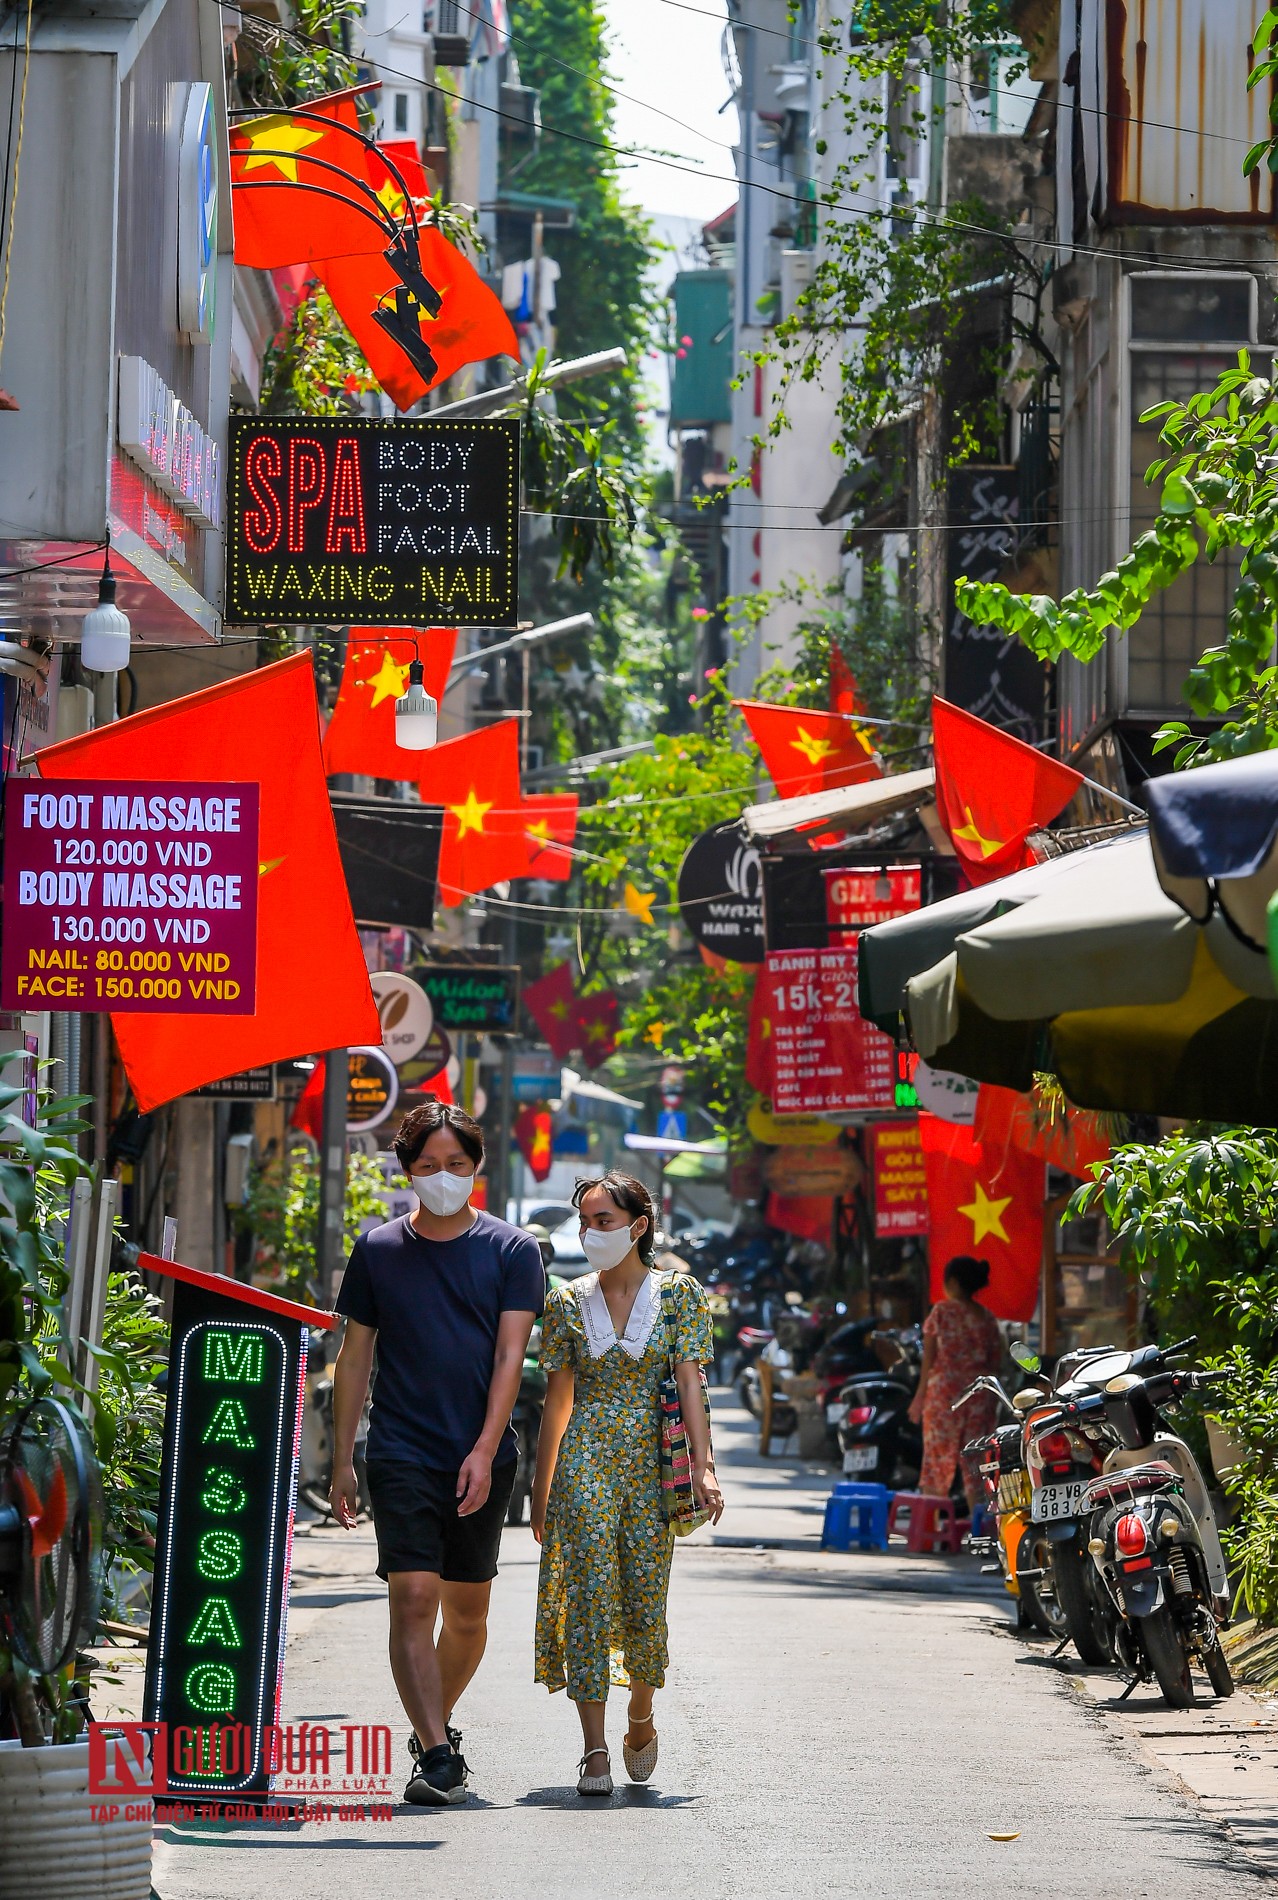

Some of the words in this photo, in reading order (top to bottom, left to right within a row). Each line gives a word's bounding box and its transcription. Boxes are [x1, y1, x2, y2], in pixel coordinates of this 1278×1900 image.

[378, 441, 475, 470] BODY
[244, 436, 368, 553] SPA
[378, 483, 471, 512] FOOT
[378, 524, 501, 555] FACIAL
[244, 563, 395, 602] WAXING
[421, 566, 501, 603] NAIL
[23, 793, 94, 830] FOOT
[102, 795, 241, 832] MASSAGE
[53, 839, 148, 866] 120.000
[155, 841, 212, 867] VND
[19, 870, 95, 906] BODY
[102, 872, 242, 909] MASSAGE
[52, 915, 147, 943] 130.000
[153, 918, 211, 943] VND
[702, 922, 741, 936] HAIR
[28, 949, 88, 970] NAIL:
[95, 950, 171, 971] 80.000
[177, 952, 230, 973] VND
[768, 954, 816, 972] BÁNH
[17, 975, 85, 997] FACE:
[95, 977, 182, 999] 150.000
[187, 979, 241, 1000] VND
[441, 999, 488, 1024] Spa
[1041, 1501, 1070, 1518] 983
[185, 1332, 264, 1778] MASSAGE
